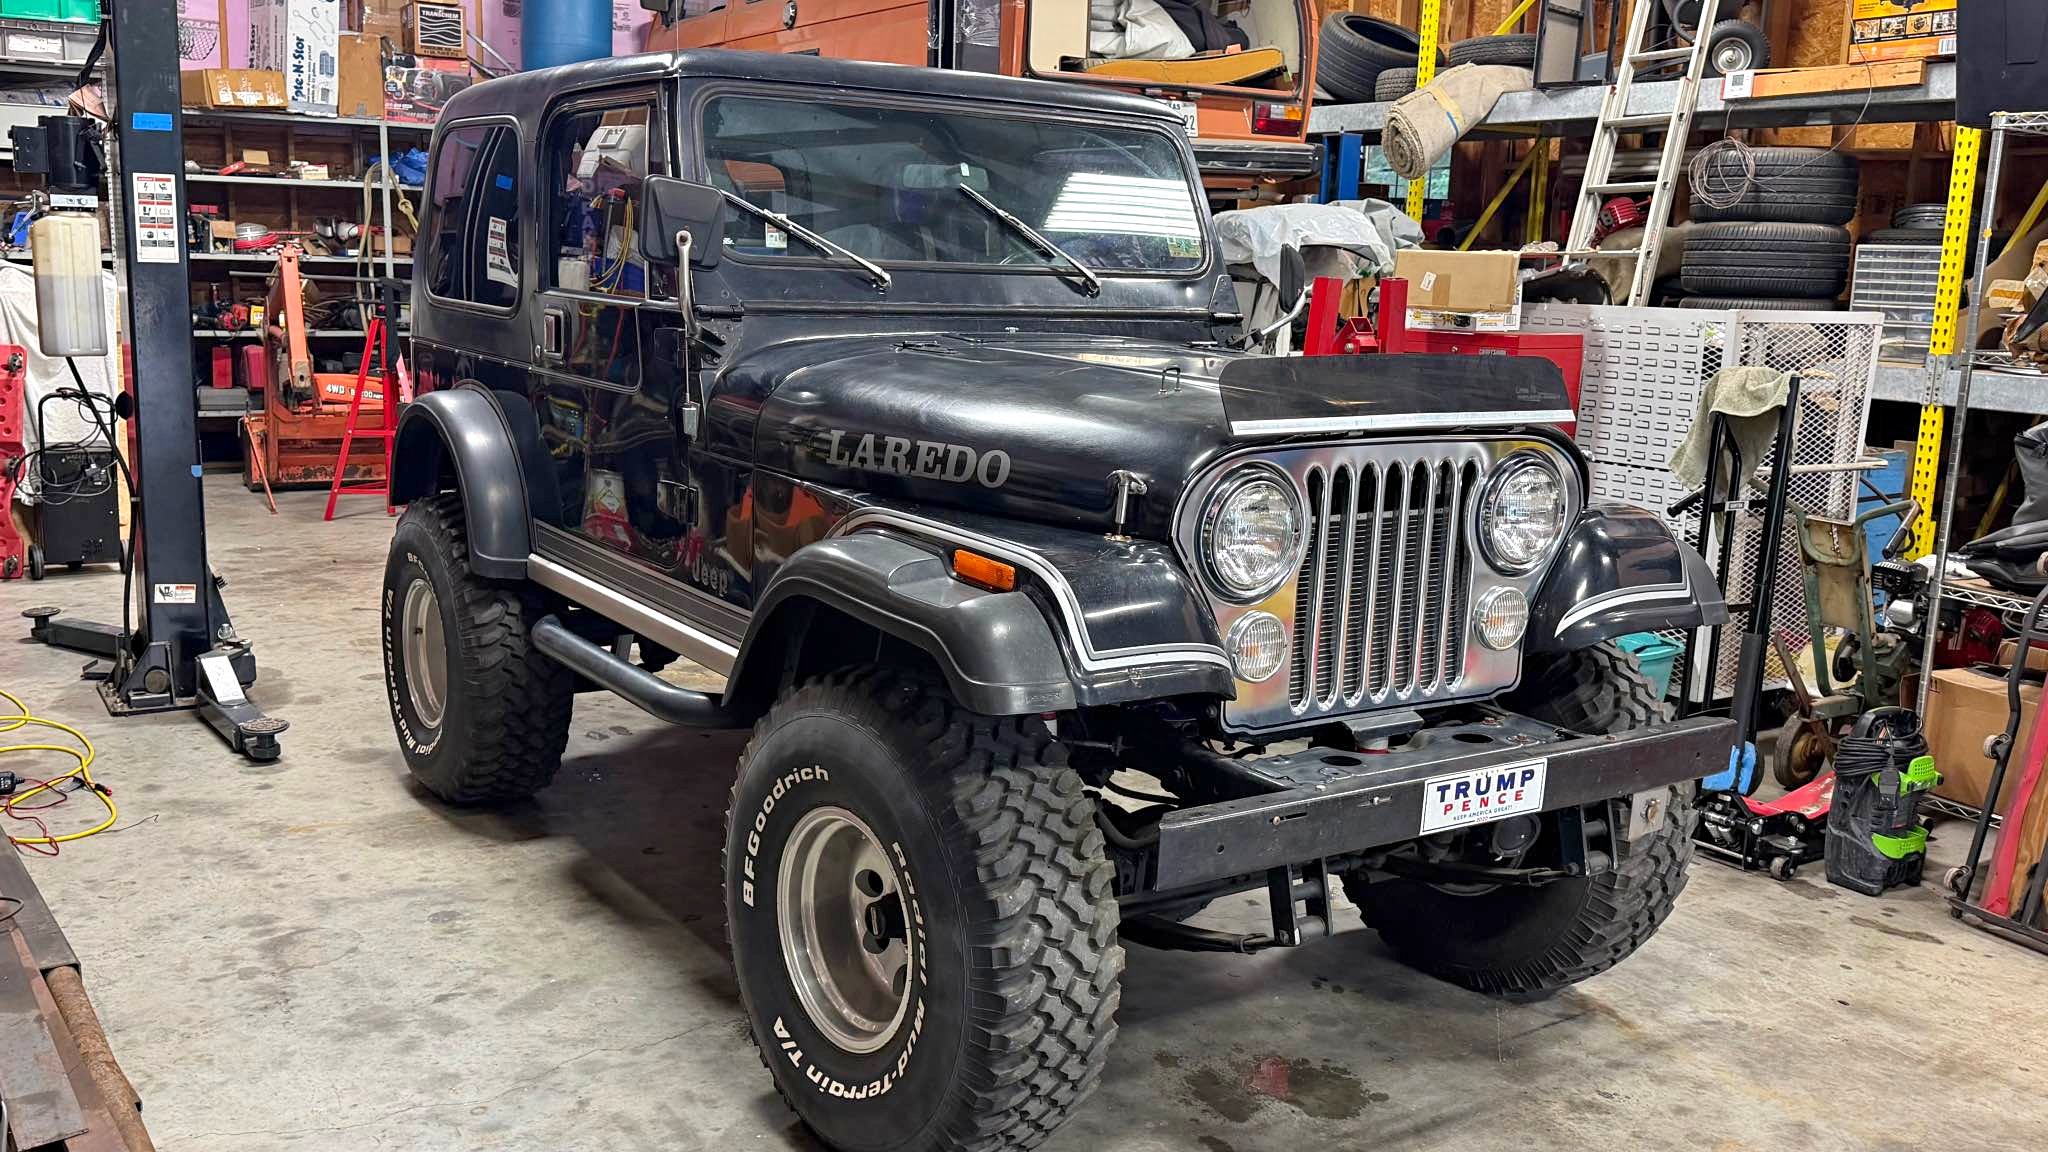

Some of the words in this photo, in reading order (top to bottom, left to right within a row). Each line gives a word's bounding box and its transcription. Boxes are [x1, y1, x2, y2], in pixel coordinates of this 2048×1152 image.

[326, 383, 345, 395] 4WD
[826, 429, 1011, 489] LAREDO
[1437, 769, 1535, 803] TRUMP
[1443, 790, 1524, 815] PENCE
[743, 764, 830, 908] BFGoodrich
[1469, 809, 1492, 818] AMERICA
[892, 841, 928, 987] Radial
[773, 1015, 803, 1068] T/A
[806, 995, 926, 1100] Mud-Terrain
